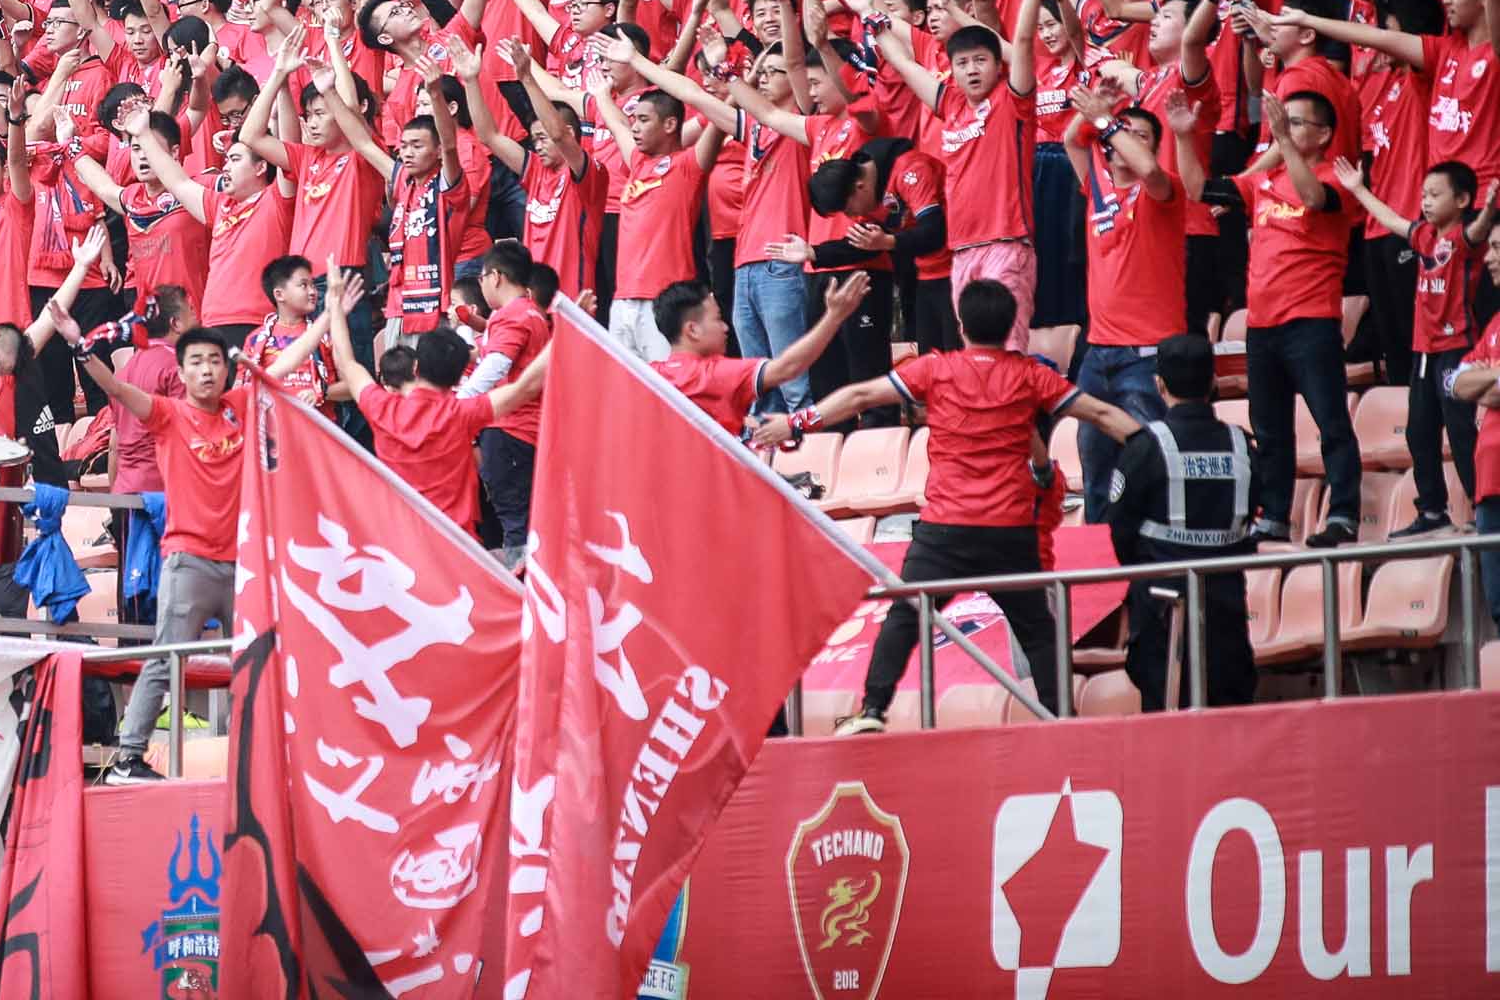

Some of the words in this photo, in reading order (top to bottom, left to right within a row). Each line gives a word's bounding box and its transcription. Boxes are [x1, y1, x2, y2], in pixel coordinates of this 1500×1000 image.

[811, 831, 885, 867] TECHAND
[1186, 797, 1434, 985] Our
[833, 969, 860, 991] 2012
